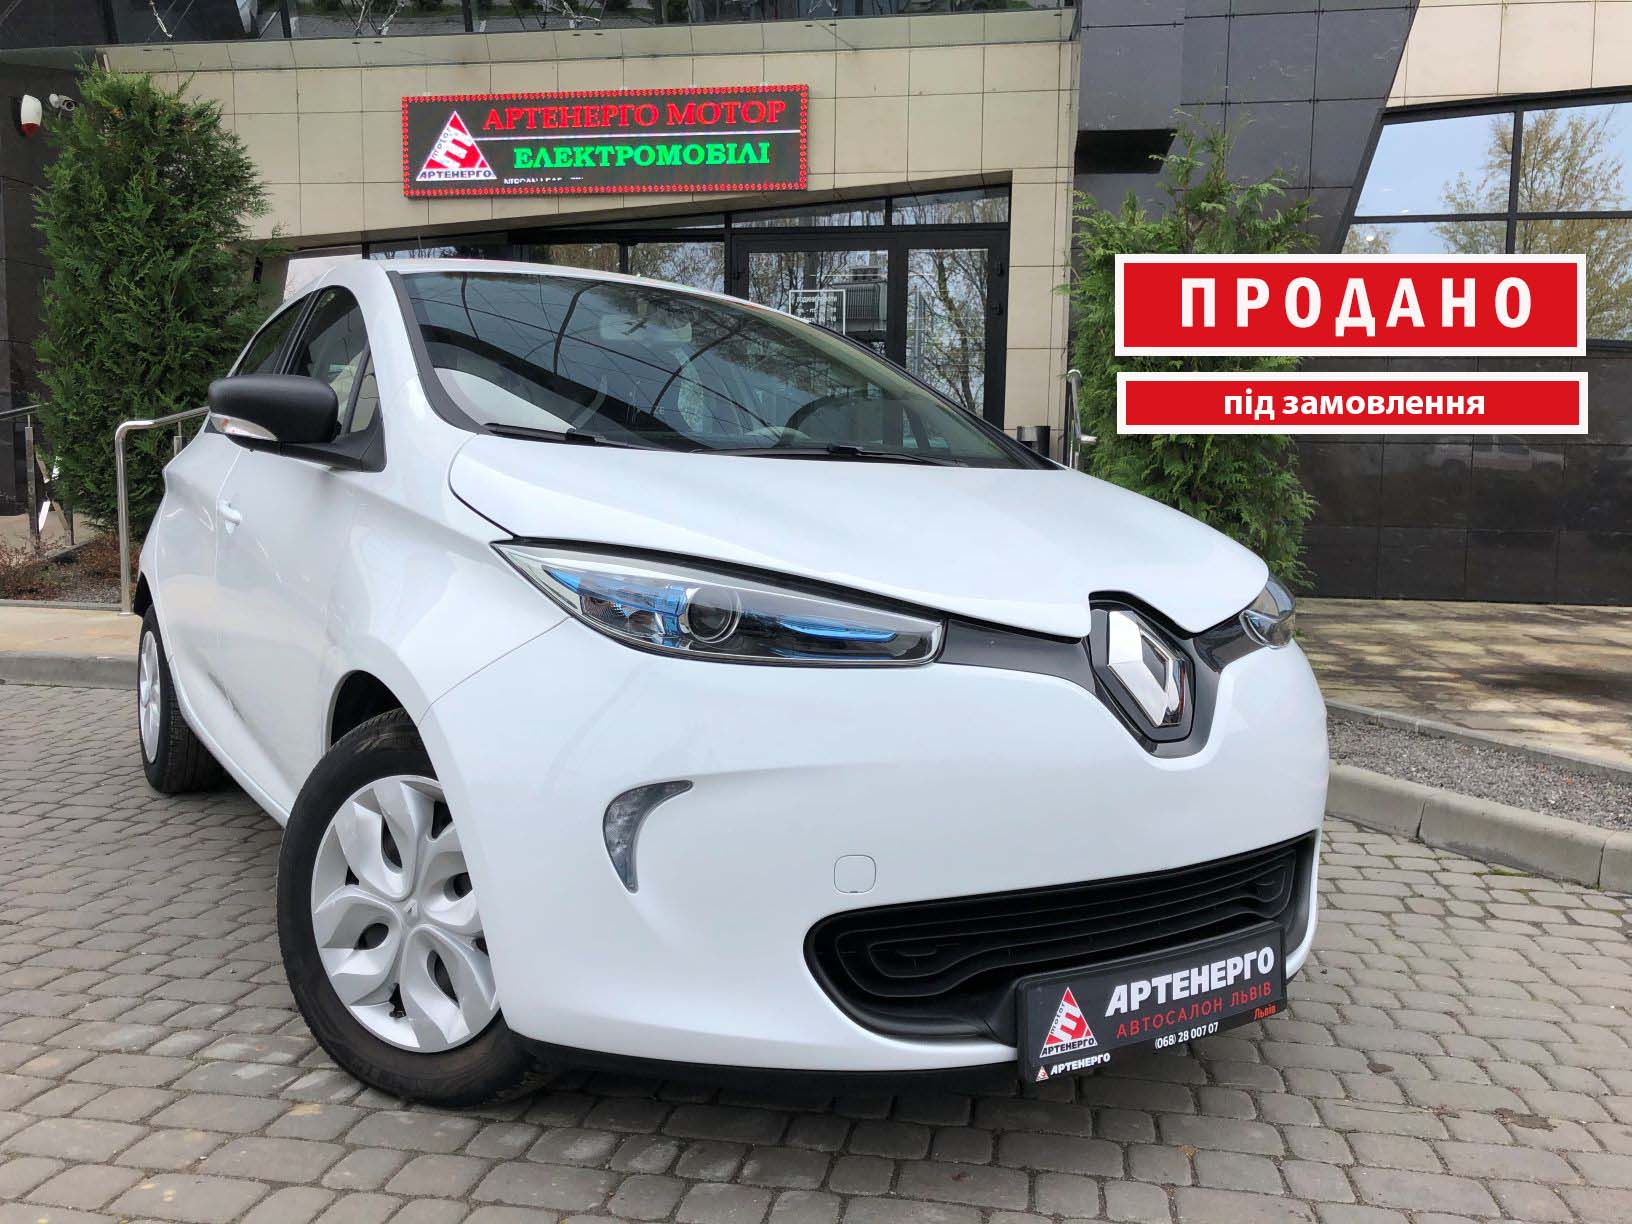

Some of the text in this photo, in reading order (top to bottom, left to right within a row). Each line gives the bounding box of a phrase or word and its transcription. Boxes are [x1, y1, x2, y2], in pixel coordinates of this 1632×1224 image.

[482, 100, 787, 130] АРТЕНЕРГО МОТОР
[513, 142, 770, 169] ЕЛЕКТРОМОБІЛІ
[419, 169, 492, 179] АРТЕНЕРГО
[1105, 946, 1275, 1017] АРТЕНЕРГО
[1116, 981, 1272, 1039] АВТОСАЛОН ЛЬВІВ
[1041, 1037, 1095, 1056] АРТЕНЕРГО
[1154, 1034, 1177, 1050] (068)
[1178, 1030, 1190, 1044] 28
[1050, 1052, 1111, 1076] АРТЕНЕРГО
